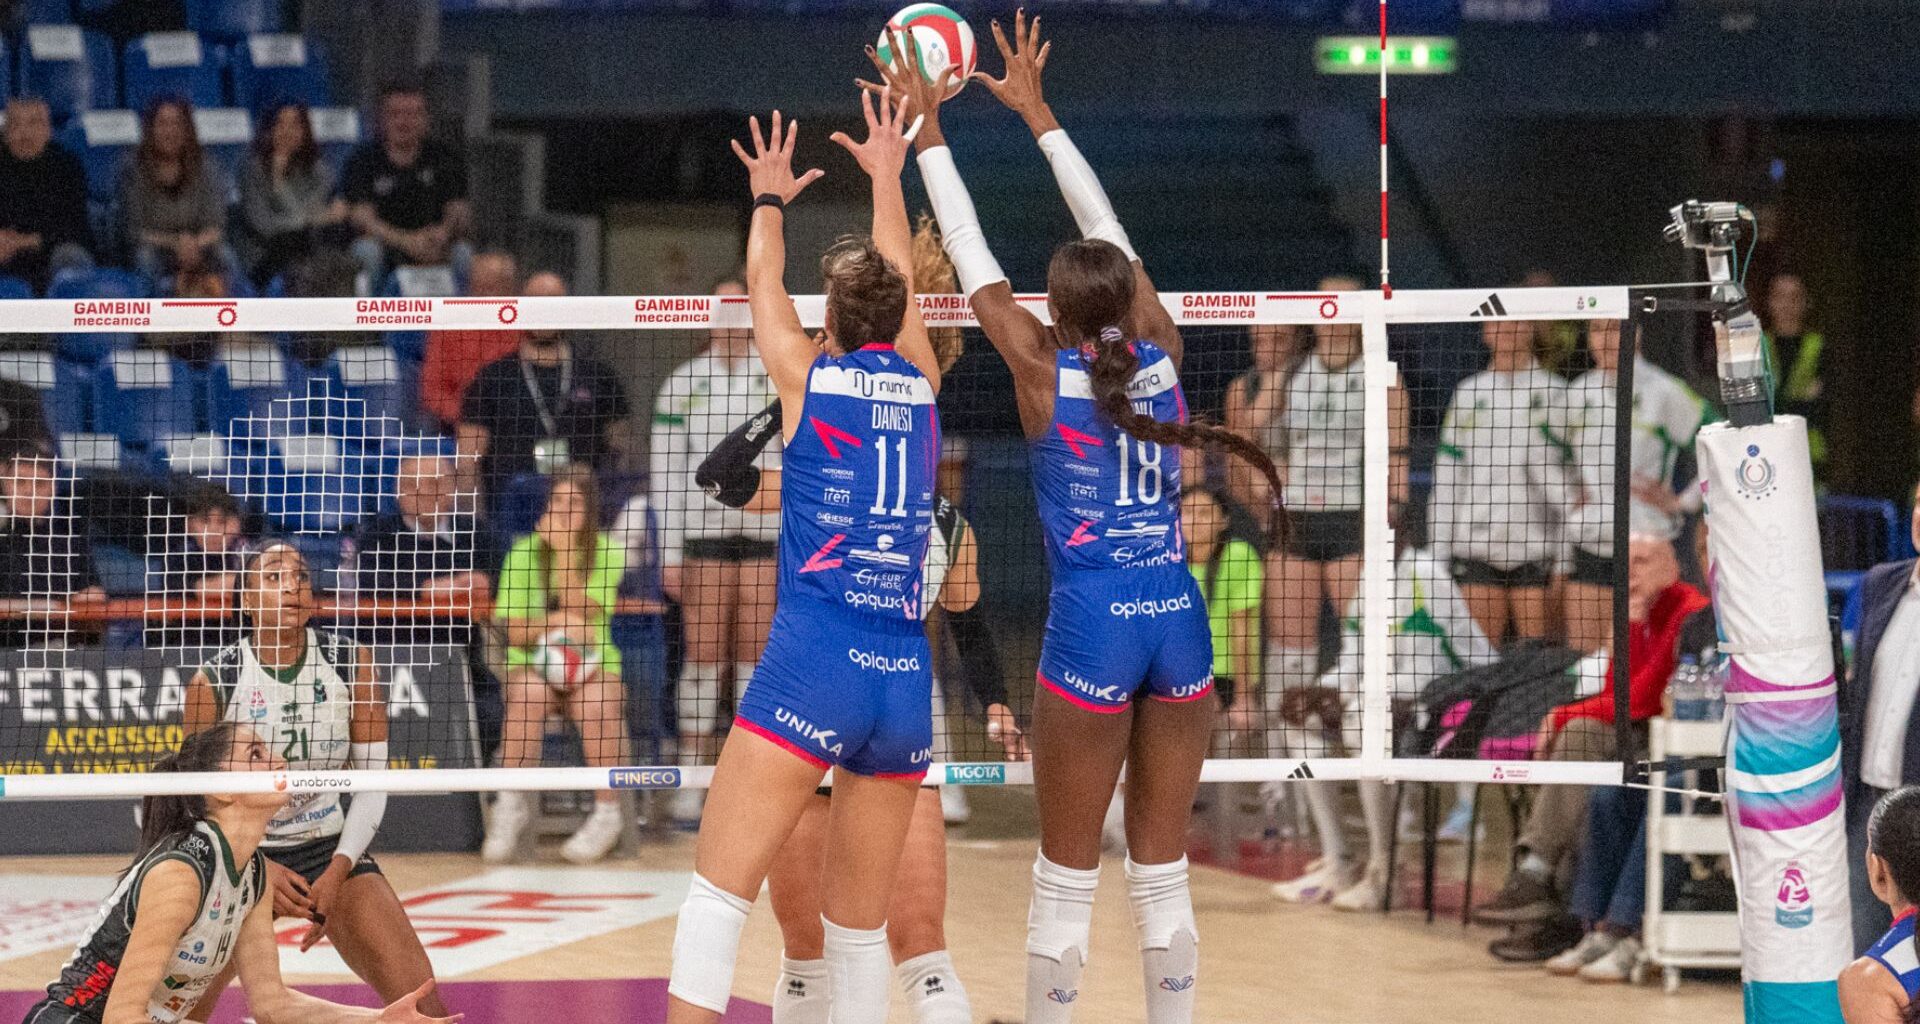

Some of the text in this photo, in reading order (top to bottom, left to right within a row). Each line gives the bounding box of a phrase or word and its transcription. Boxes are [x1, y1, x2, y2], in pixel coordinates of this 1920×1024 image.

[74, 302, 150, 314] GAMBINI
[356, 300, 432, 312] GAMBINI
[635, 299, 710, 311] GAMBINI
[1183, 295, 1256, 307] GAMBINI
[74, 317, 150, 326] meccanica
[356, 315, 432, 324] meccanica
[635, 313, 709, 322] meccanica
[1183, 310, 1255, 319] meccanica
[872, 403, 912, 432] DANESI
[1115, 432, 1162, 505] 18
[869, 435, 907, 518] 11
[1110, 592, 1192, 620] opiquad
[1064, 671, 1128, 702] UNIKA
[775, 707, 843, 757] UNIKA
[45, 725, 184, 755] ACCESSO
[281, 727, 308, 762] 21
[292, 775, 352, 787] unobravo
[614, 771, 676, 785] FINECO
[178, 950, 207, 965] BHS
